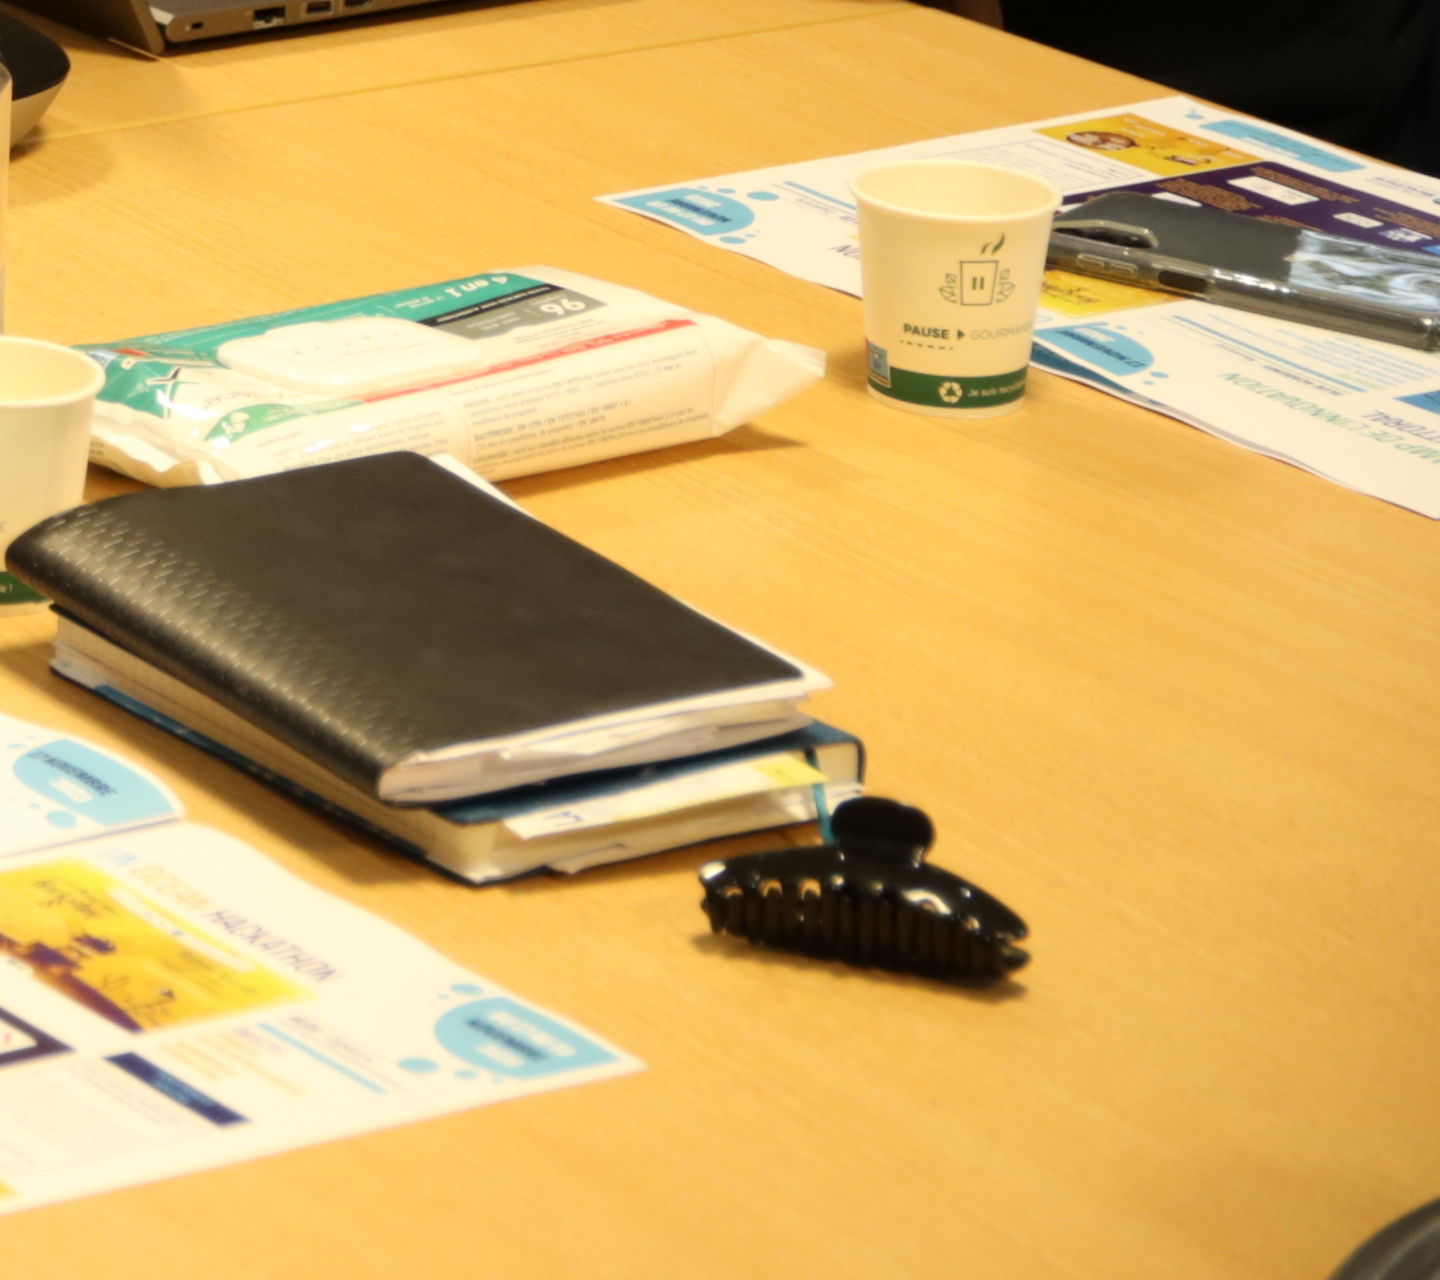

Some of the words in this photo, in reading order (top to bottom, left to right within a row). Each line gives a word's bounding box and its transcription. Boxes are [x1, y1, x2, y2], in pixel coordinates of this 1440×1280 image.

[459, 278, 490, 293] en
[539, 298, 586, 316] 96
[903, 323, 950, 340] PAUSE
[201, 910, 342, 983] HACKATHON
